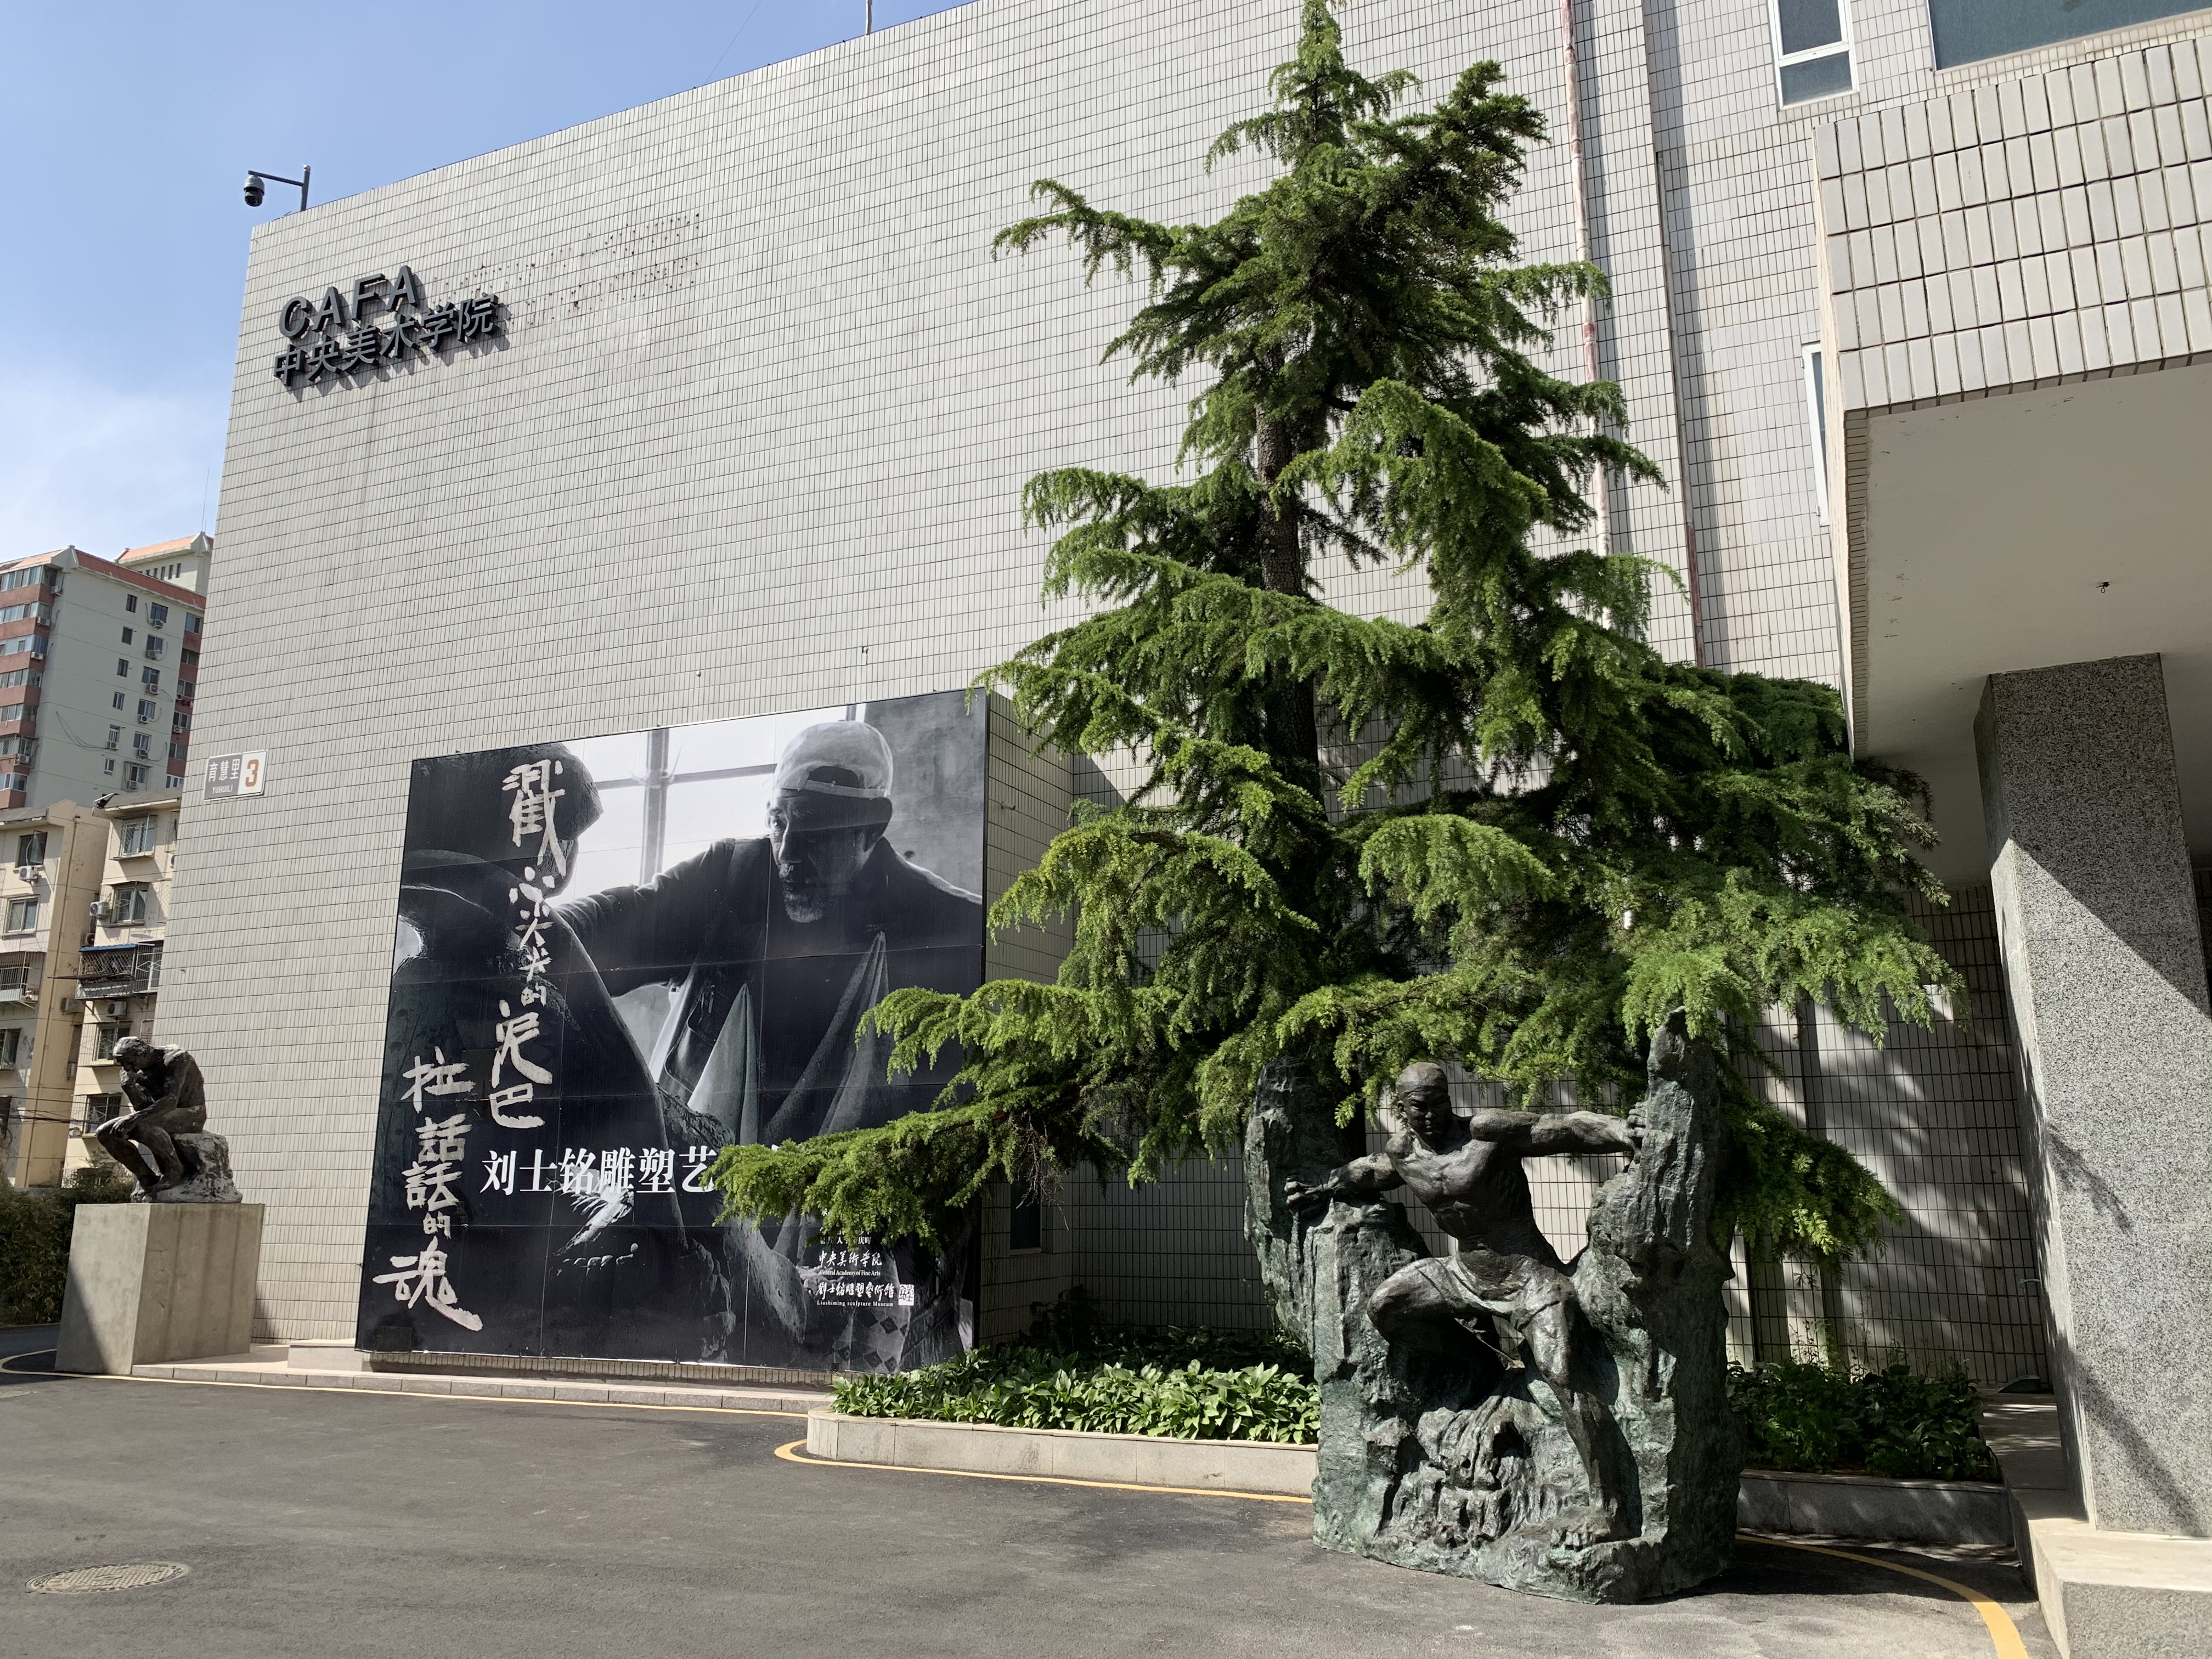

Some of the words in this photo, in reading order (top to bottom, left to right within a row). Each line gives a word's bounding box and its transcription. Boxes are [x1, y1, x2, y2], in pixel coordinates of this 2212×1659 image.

[279, 264, 419, 339] CAFA
[274, 292, 499, 387] 中央美术学院
[208, 758, 240, 782] 育慧里
[245, 759, 259, 787] 3
[212, 785, 233, 794] YUHUILI
